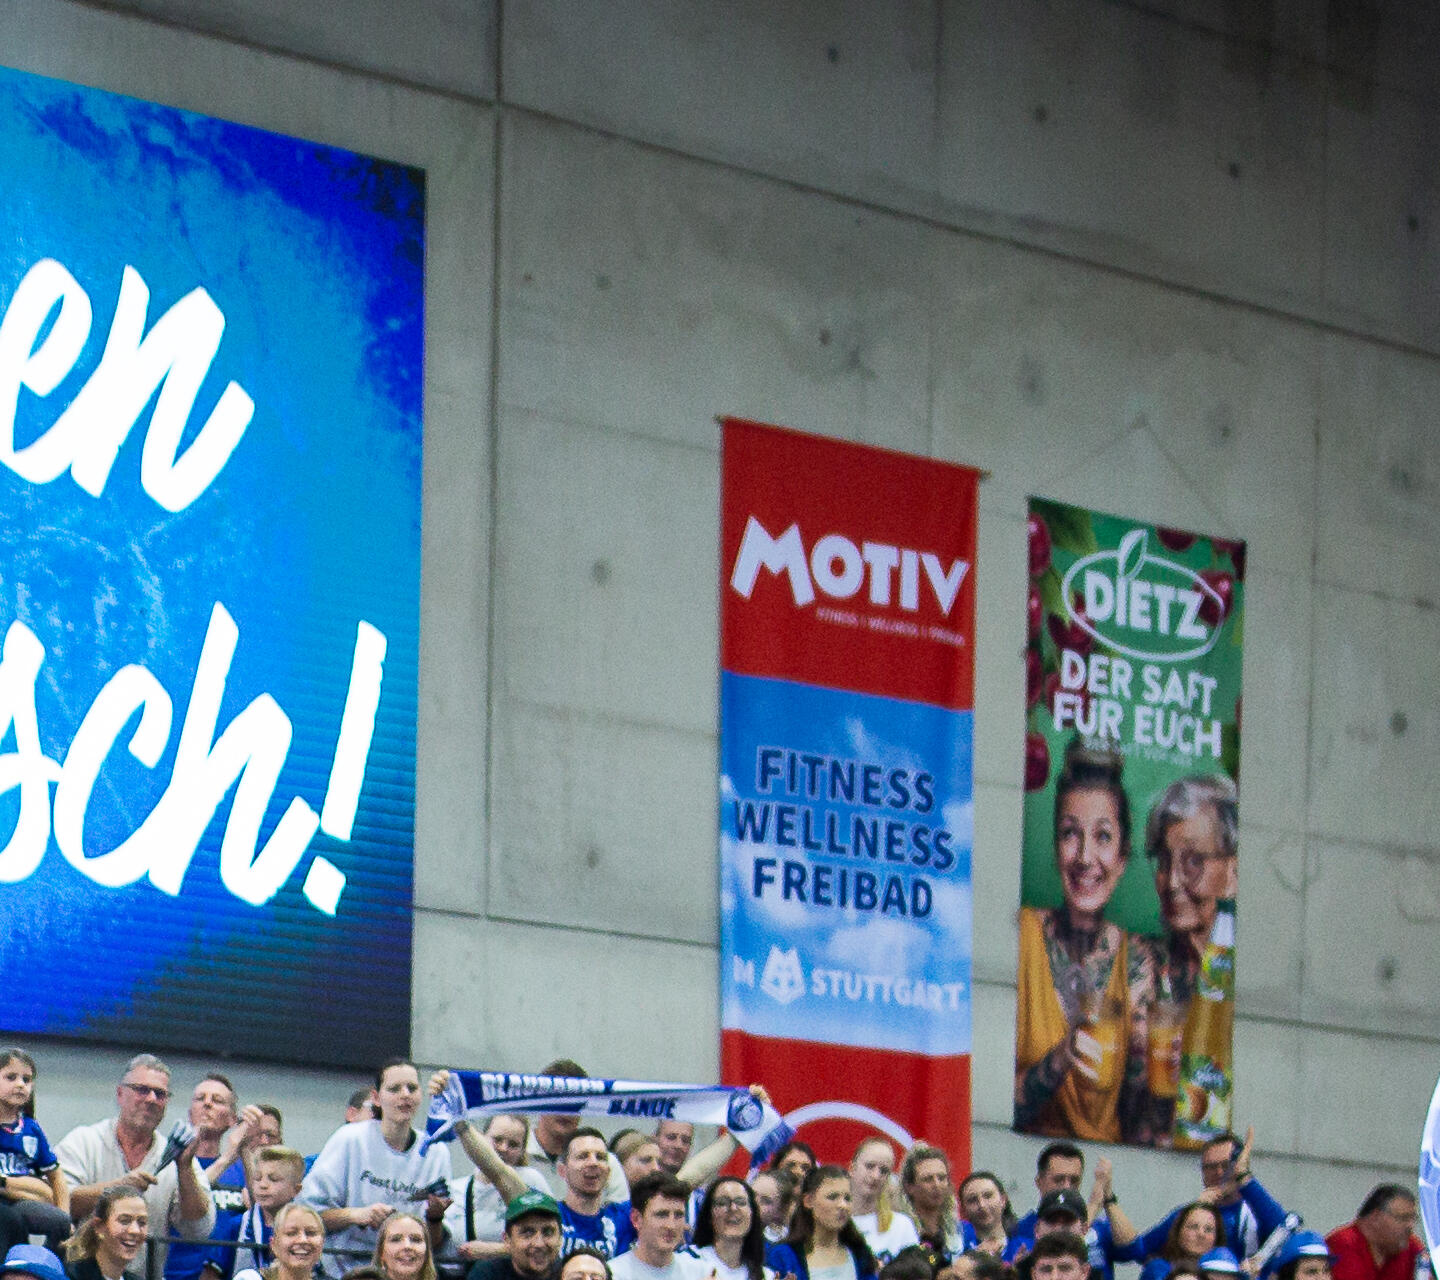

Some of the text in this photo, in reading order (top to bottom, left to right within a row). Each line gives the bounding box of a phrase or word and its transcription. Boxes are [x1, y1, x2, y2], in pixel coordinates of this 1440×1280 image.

[730, 514, 970, 617] MOTIV
[1084, 569, 1208, 640] DIETZ
[1060, 648, 1218, 716] DER SAFT
[1134, 704, 1222, 758] EUCH
[757, 747, 934, 815] FITNESS
[733, 800, 956, 871] WELLNESS
[753, 856, 933, 918] FREIBAD
[810, 967, 965, 1013] STUTTGART
